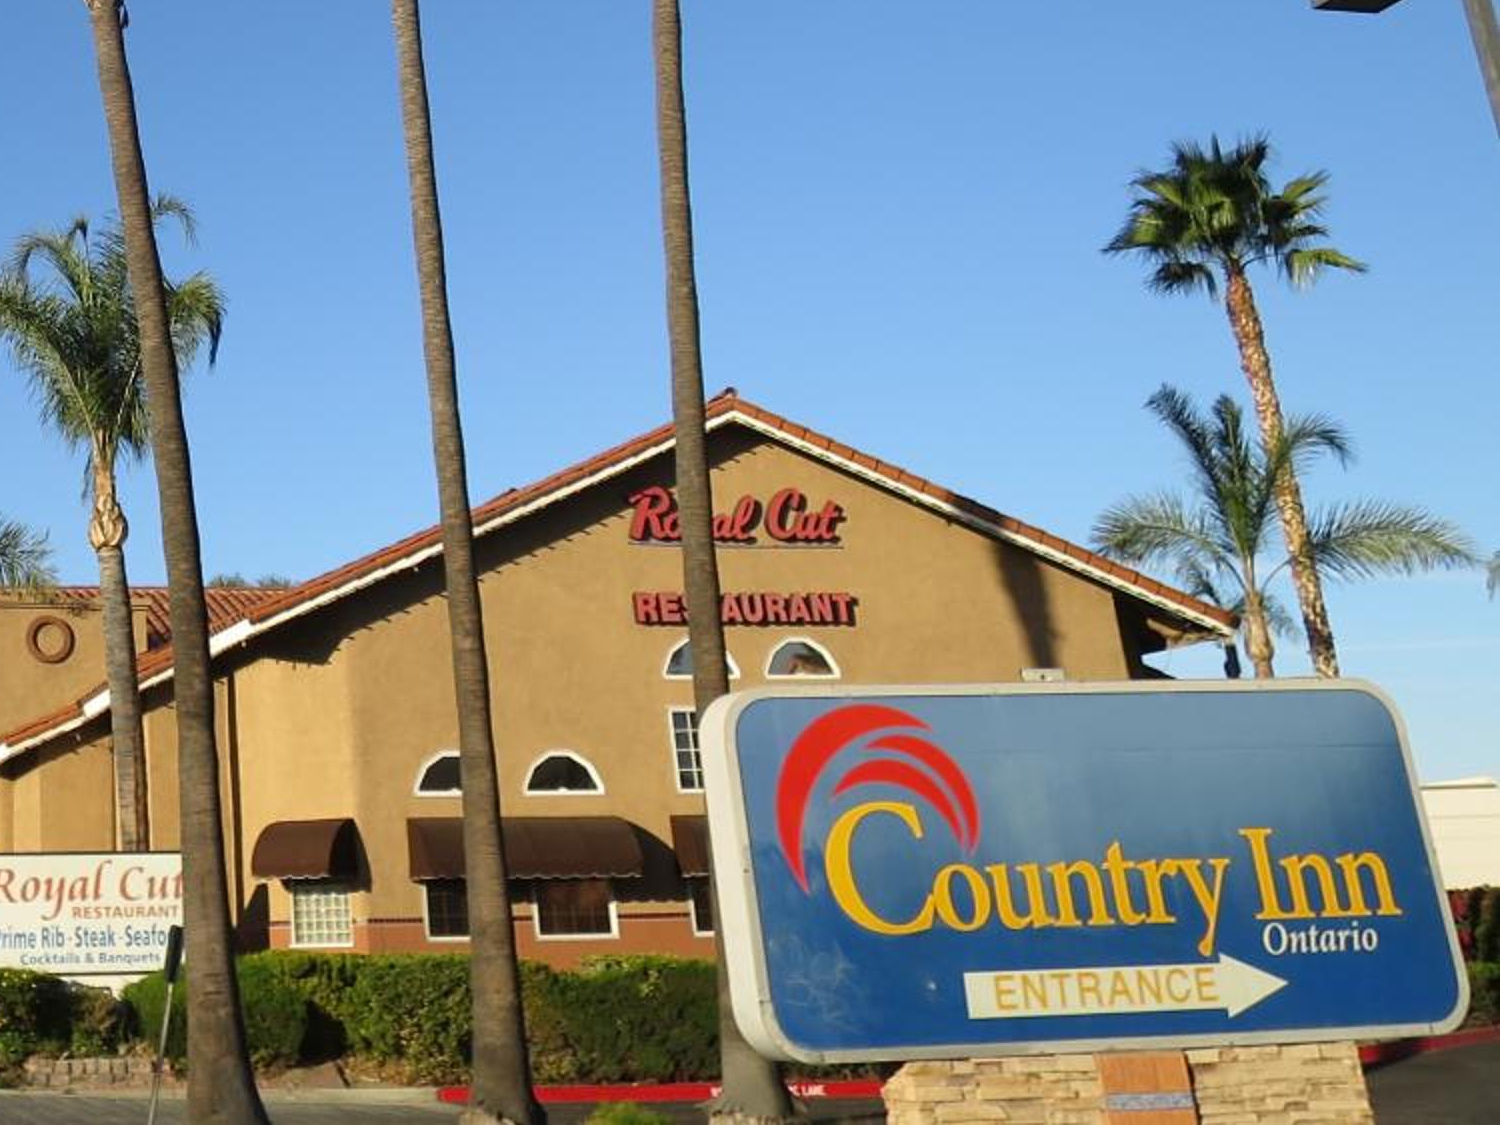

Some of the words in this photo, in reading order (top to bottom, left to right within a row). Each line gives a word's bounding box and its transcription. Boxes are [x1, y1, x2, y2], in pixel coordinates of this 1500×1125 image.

[628, 485, 758, 544] Roal
[766, 487, 847, 544] Cut
[632, 592, 857, 626] REAURANT
[824, 800, 1231, 958] Country
[1238, 826, 1403, 920] Inn
[71, 904, 179, 920] RESTAURANT
[41, 926, 66, 949] Rib
[74, 925, 117, 949] Steak
[125, 923, 168, 948] Seafo
[1262, 922, 1380, 956] Ontario
[19, 954, 81, 967] Cocktails
[84, 953, 95, 965] &
[99, 951, 162, 966] Banquets
[994, 967, 1221, 1013] ENTRANCE
